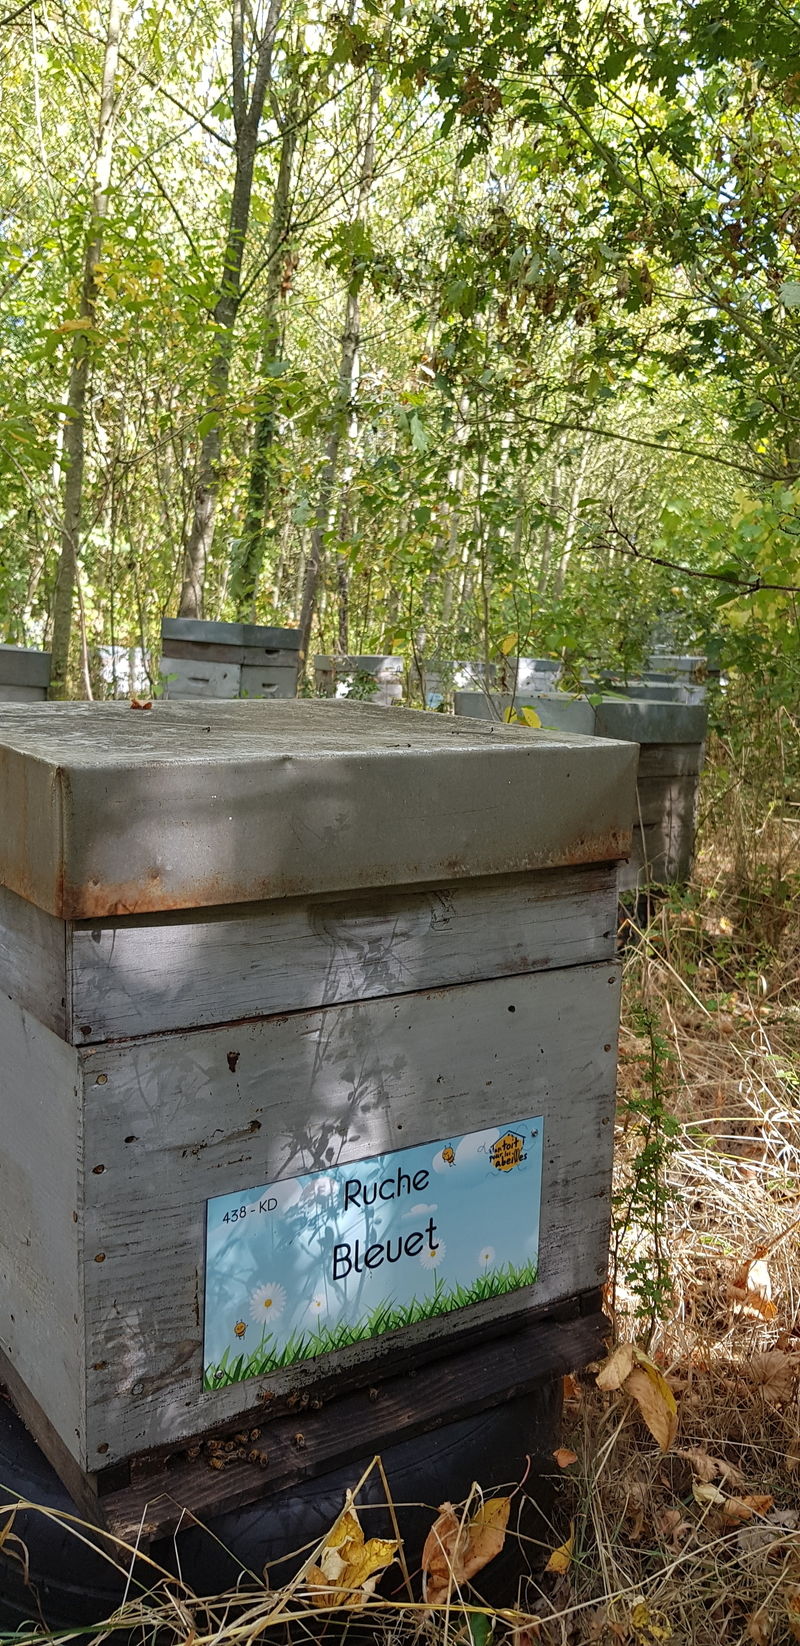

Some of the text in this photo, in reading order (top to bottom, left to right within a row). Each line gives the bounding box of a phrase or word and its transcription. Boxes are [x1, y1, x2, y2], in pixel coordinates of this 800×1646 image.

[502, 1137, 519, 1150] toit
[495, 1149, 528, 1168] abeilles
[344, 1167, 430, 1211] Ruche
[222, 1205, 247, 1224] 438
[259, 1198, 278, 1213] KD
[332, 1217, 440, 1281] Bleuet
